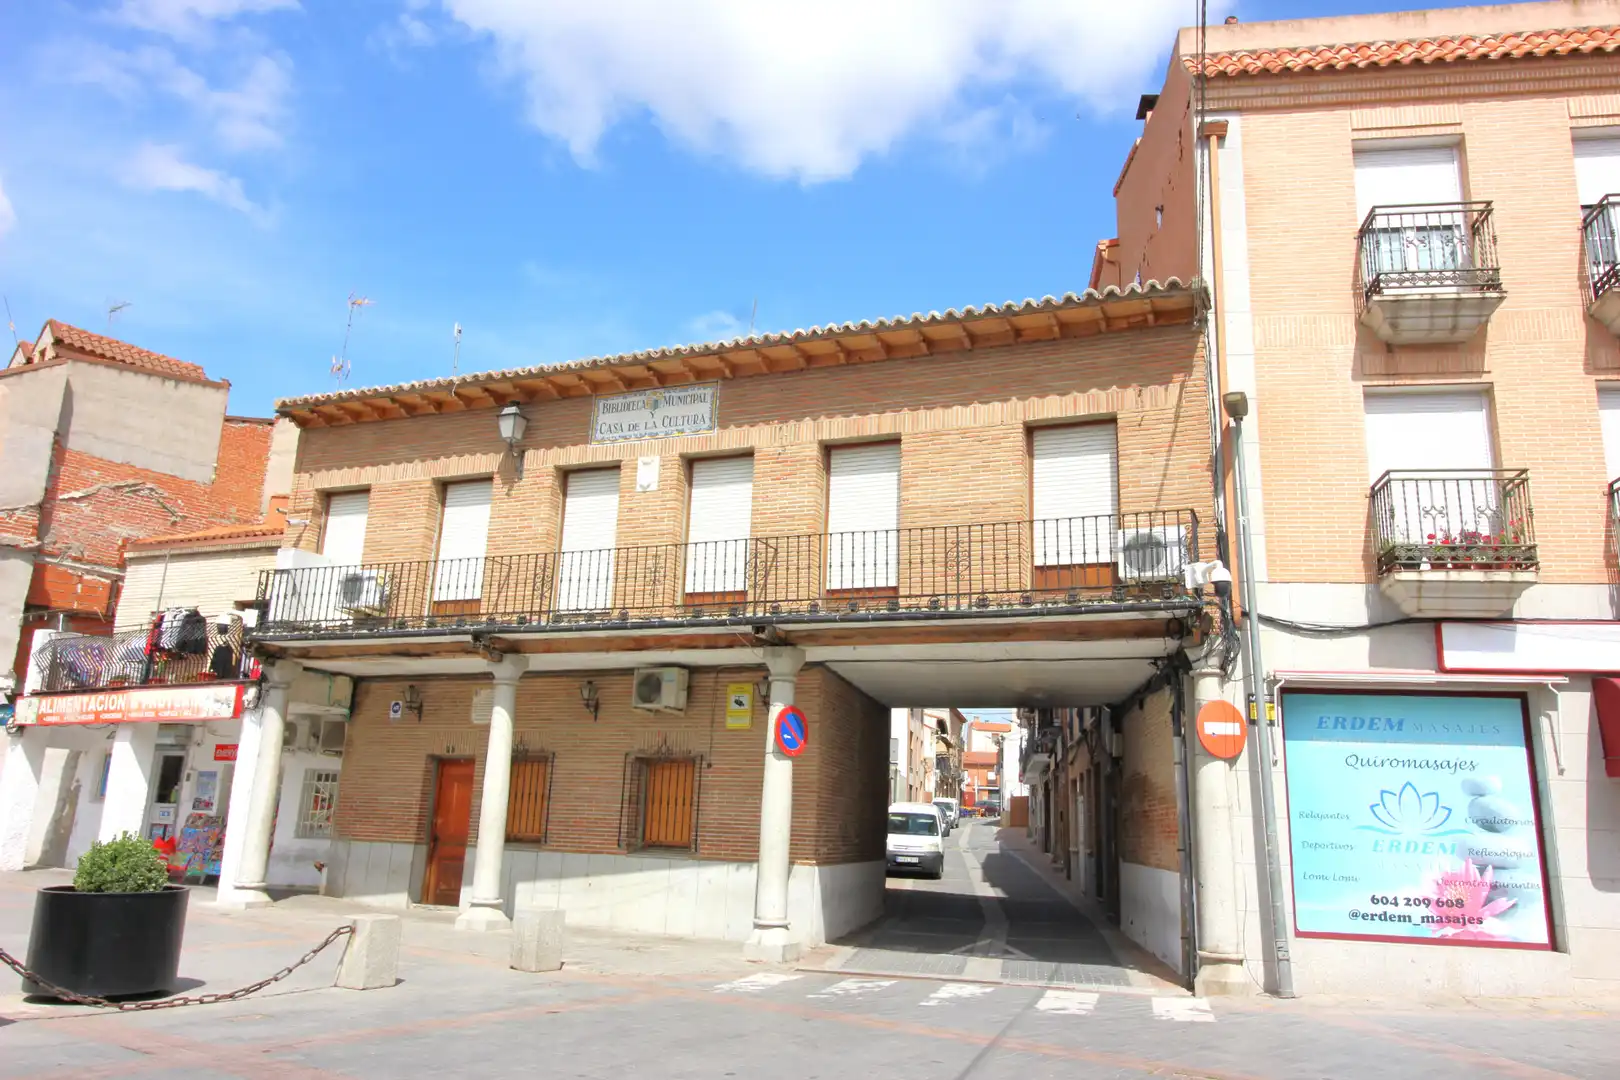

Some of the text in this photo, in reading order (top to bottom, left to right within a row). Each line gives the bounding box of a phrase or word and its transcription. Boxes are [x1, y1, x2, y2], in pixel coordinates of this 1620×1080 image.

[662, 392, 708, 407] MUNICIPAL
[649, 410, 657, 419] Y
[599, 413, 706, 435] CASA DE LA CULTURA
[1316, 715, 1501, 735] ERDEM MASAJES
[1345, 754, 1478, 774] Quiromasajes
[1298, 810, 1350, 821] Relajantes
[1301, 840, 1354, 851] Deportivos
[1372, 840, 1457, 855] ERDEM
[1370, 894, 1465, 908] 604 209 608
[1348, 909, 1484, 926] @erdem_masajes
